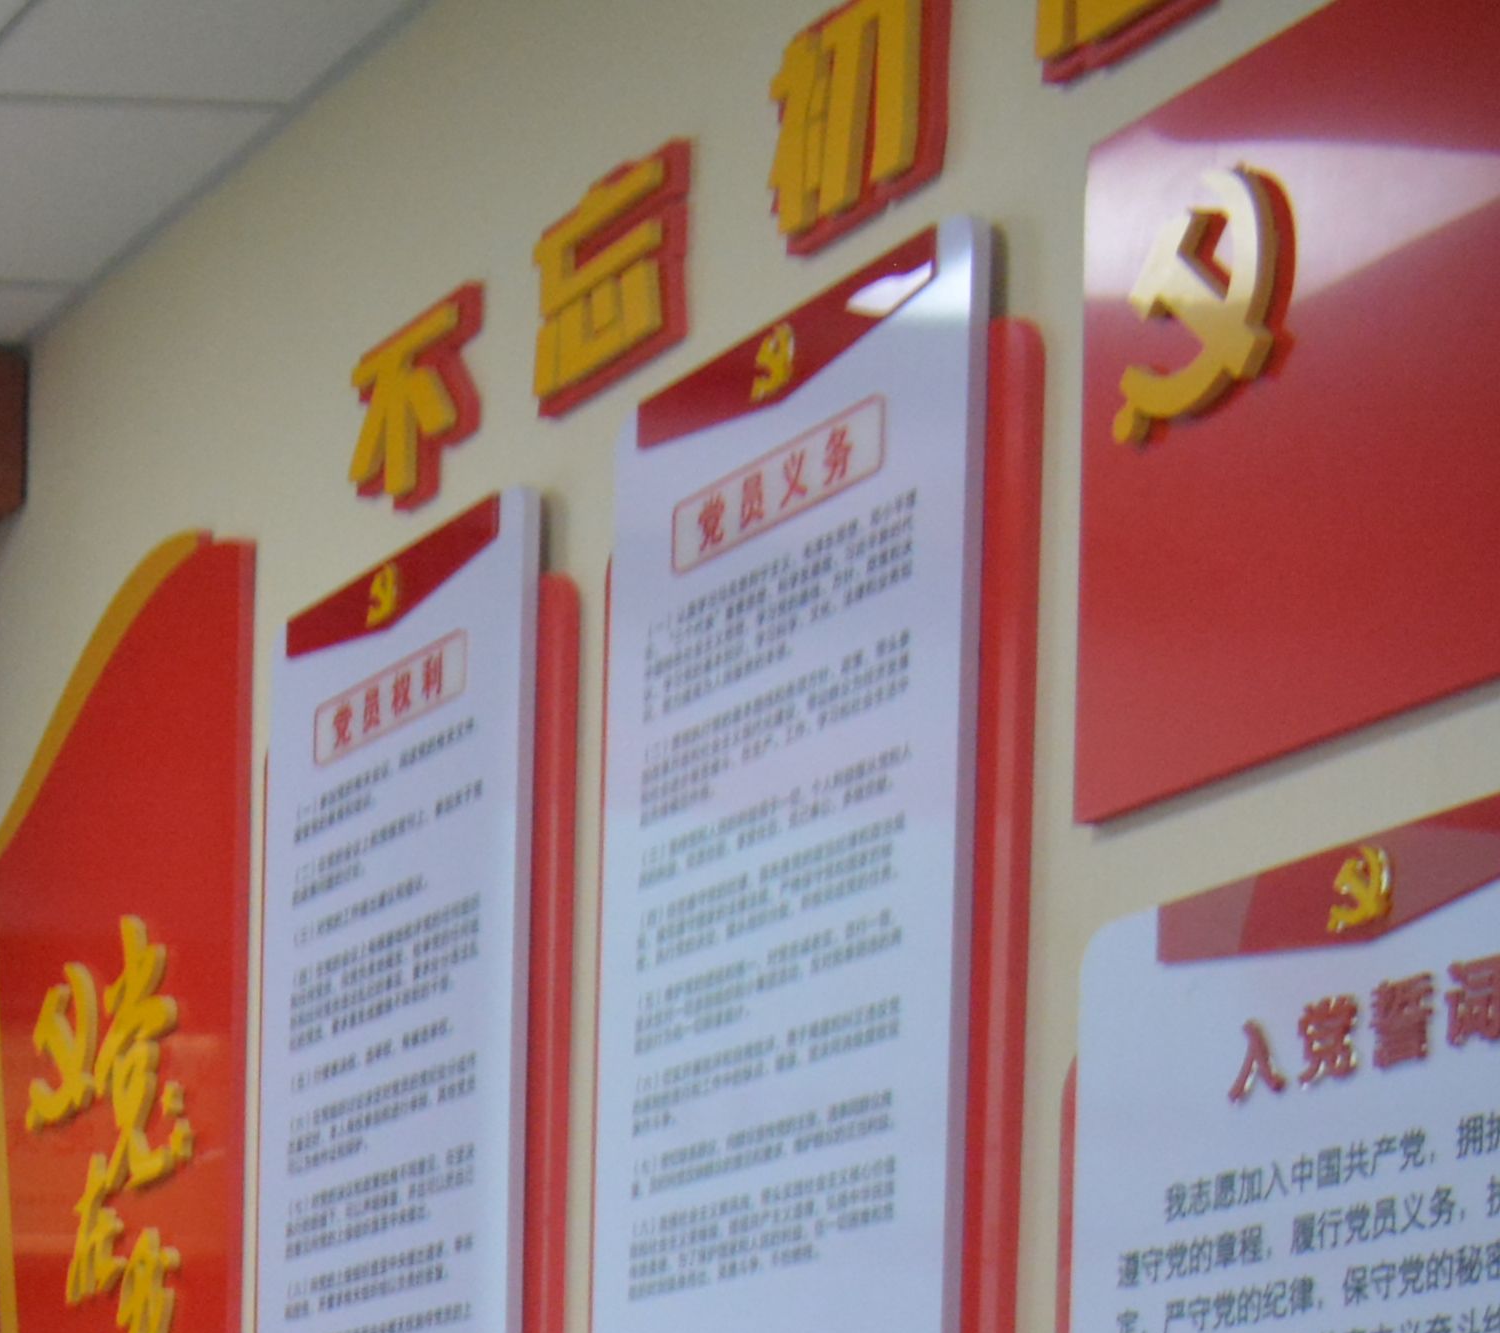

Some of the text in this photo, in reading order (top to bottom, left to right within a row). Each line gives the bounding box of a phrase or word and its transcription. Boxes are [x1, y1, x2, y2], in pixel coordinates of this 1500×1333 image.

[350, 0, 1222, 512] 不忘初
[696, 423, 853, 553] 党员义务
[331, 650, 444, 751] 党员权利
[1227, 952, 1500, 1105] 入党誓词
